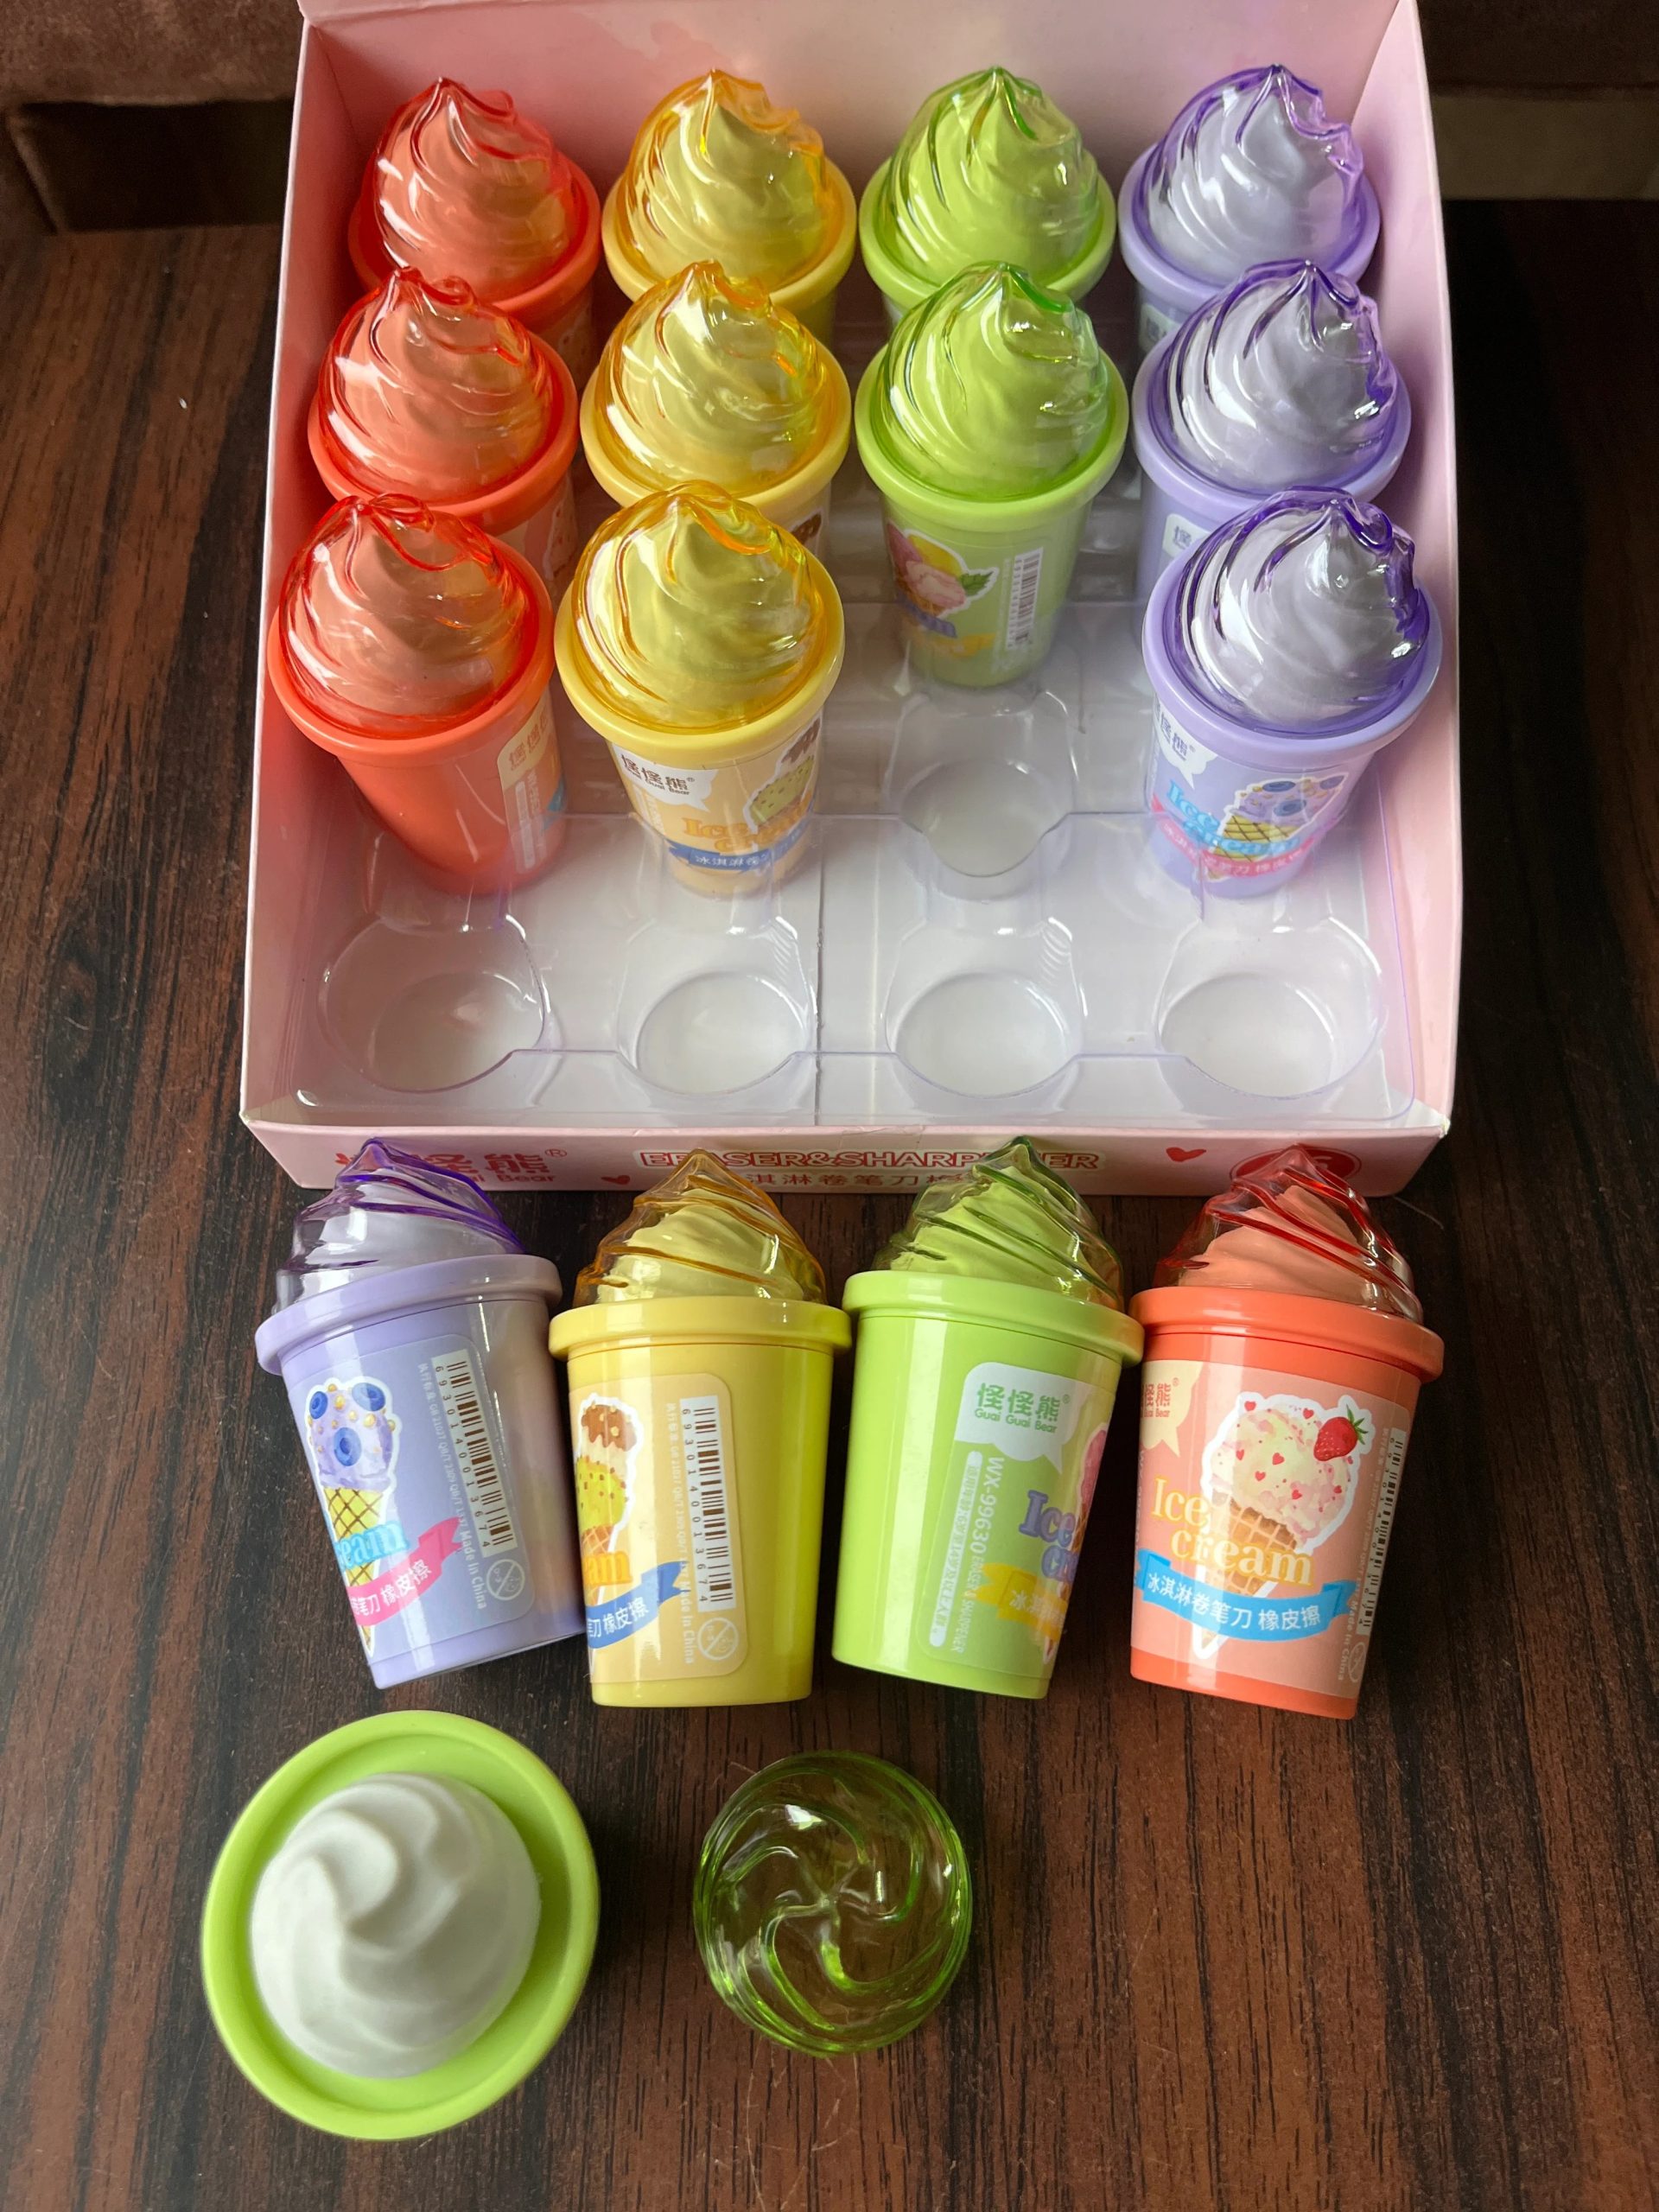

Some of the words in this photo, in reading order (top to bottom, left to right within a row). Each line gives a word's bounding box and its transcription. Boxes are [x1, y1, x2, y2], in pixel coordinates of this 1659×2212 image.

[497, 1173, 556, 1182] Bear
[977, 1382, 1061, 1422] 怪怪熊
[1034, 1420, 1058, 1433] Bear
[434, 1364, 492, 1548] 6930140013674
[682, 1408, 708, 1602] 6930140013674
[968, 1454, 1005, 1555] WX-99630
[1019, 1490, 1077, 1548] Ice
[1152, 1478, 1208, 1527] Ice
[381, 1559, 431, 1606] 橡皮擦
[458, 1529, 478, 1561] Made
[469, 1574, 492, 1610] China
[1171, 1528, 1314, 1586] cream
[603, 1596, 649, 1634] 橡皮擦
[1147, 1573, 1252, 1629] 冰淇淋卷笔刀
[1258, 1605, 1320, 1631] 橡皮擦
[682, 1629, 698, 1664] China
